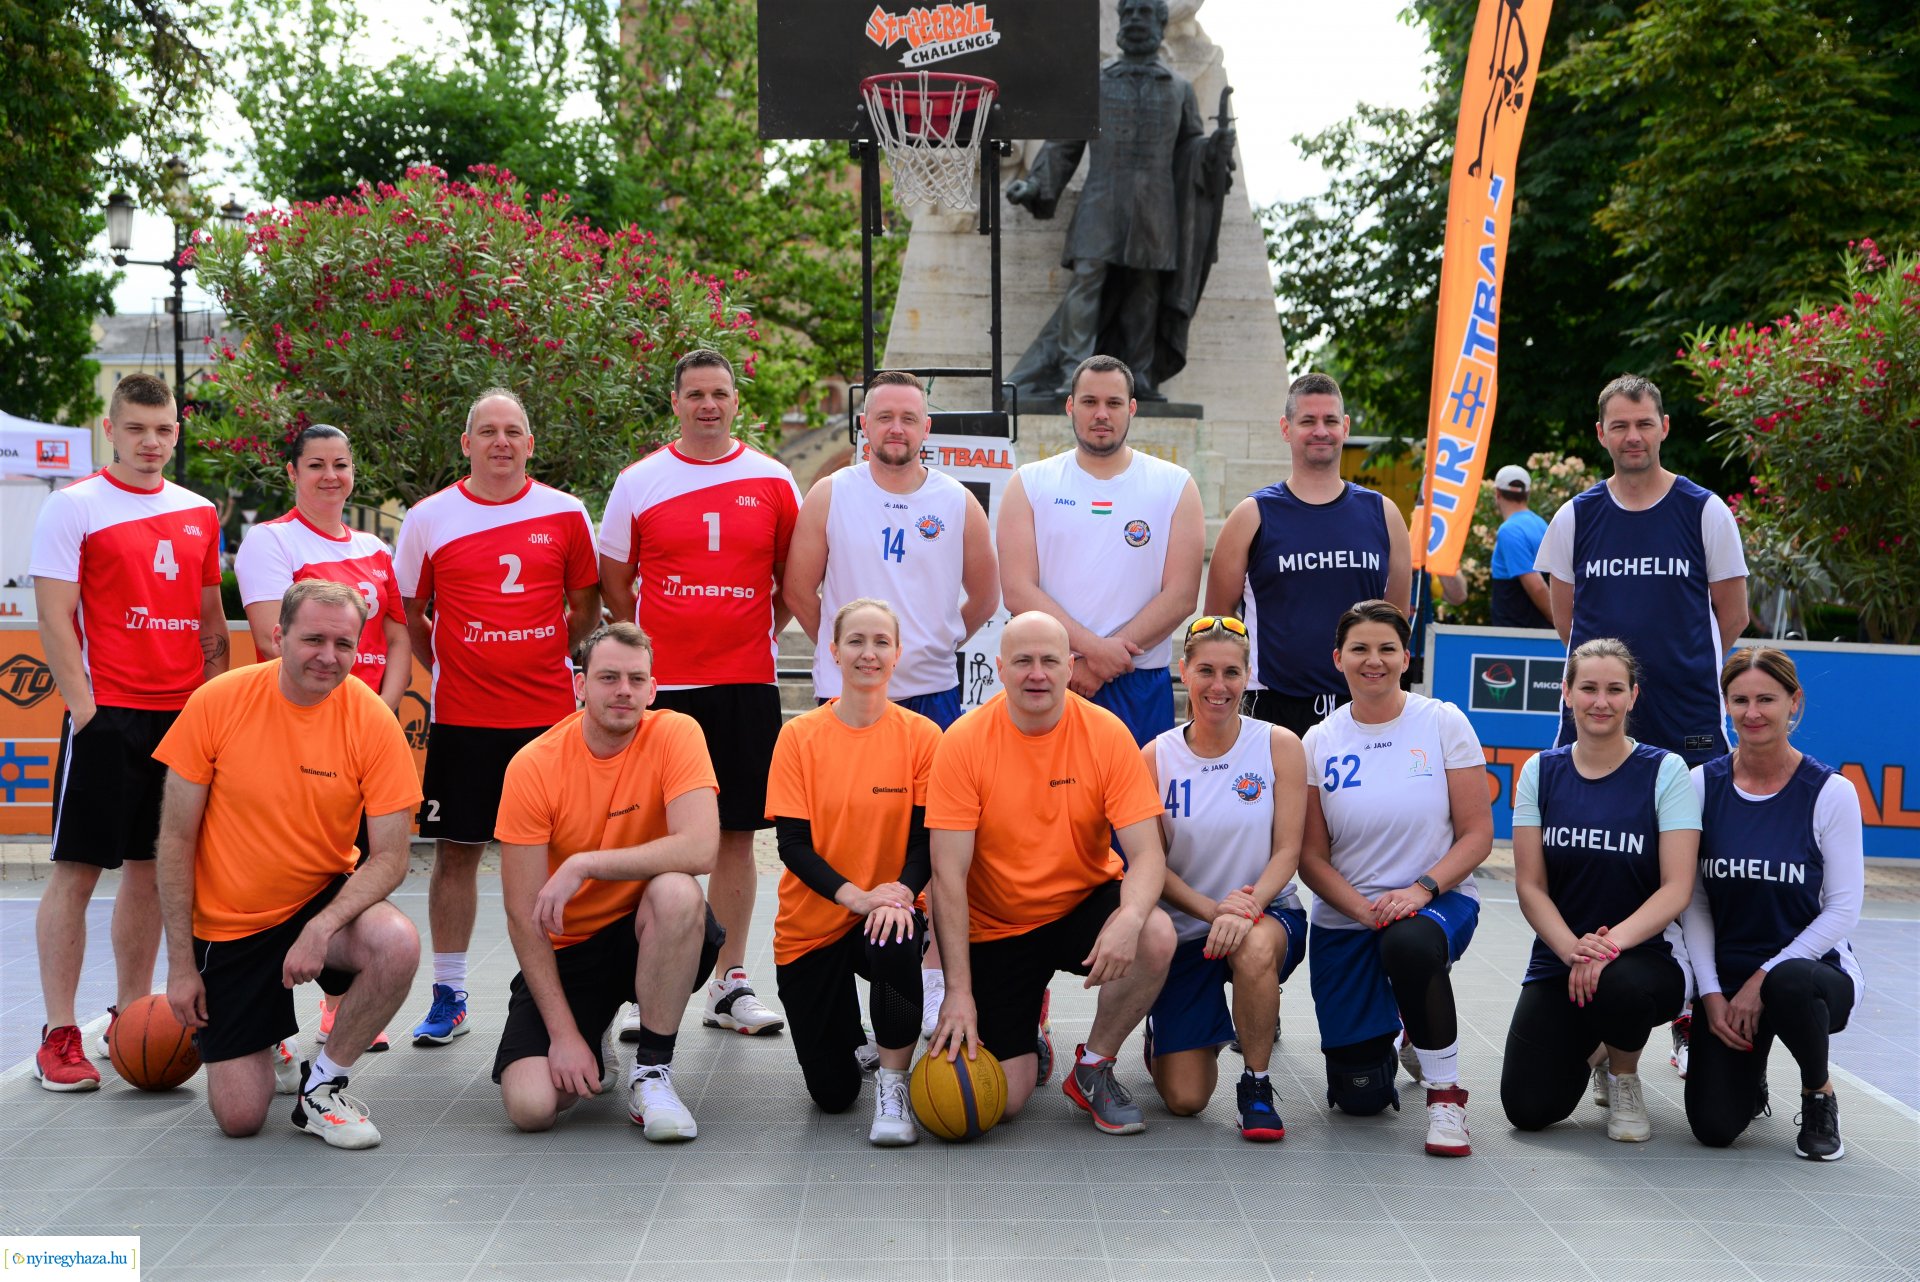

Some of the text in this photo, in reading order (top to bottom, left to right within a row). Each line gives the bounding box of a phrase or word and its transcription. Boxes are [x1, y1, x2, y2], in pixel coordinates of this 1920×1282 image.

[911, 33, 994, 64] CHALLENGE
[1054, 498, 1076, 507] JAKO
[702, 512, 721, 552] 1
[881, 526, 906, 563] 14
[153, 539, 180, 581] 4
[498, 553, 525, 594] 2
[1278, 550, 1380, 573] MICHELIN
[1585, 556, 1690, 579] MICHELIN
[357, 581, 380, 621] 3
[681, 584, 756, 600] marso
[483, 625, 556, 642] marso
[1373, 741, 1393, 750] JAKO
[1211, 763, 1230, 772] JAKO
[1323, 754, 1362, 793] 52
[427, 799, 441, 822] 2
[1164, 778, 1192, 819] 41
[1542, 826, 1645, 855] MICHELIN
[1700, 857, 1806, 884] MICHELIN
